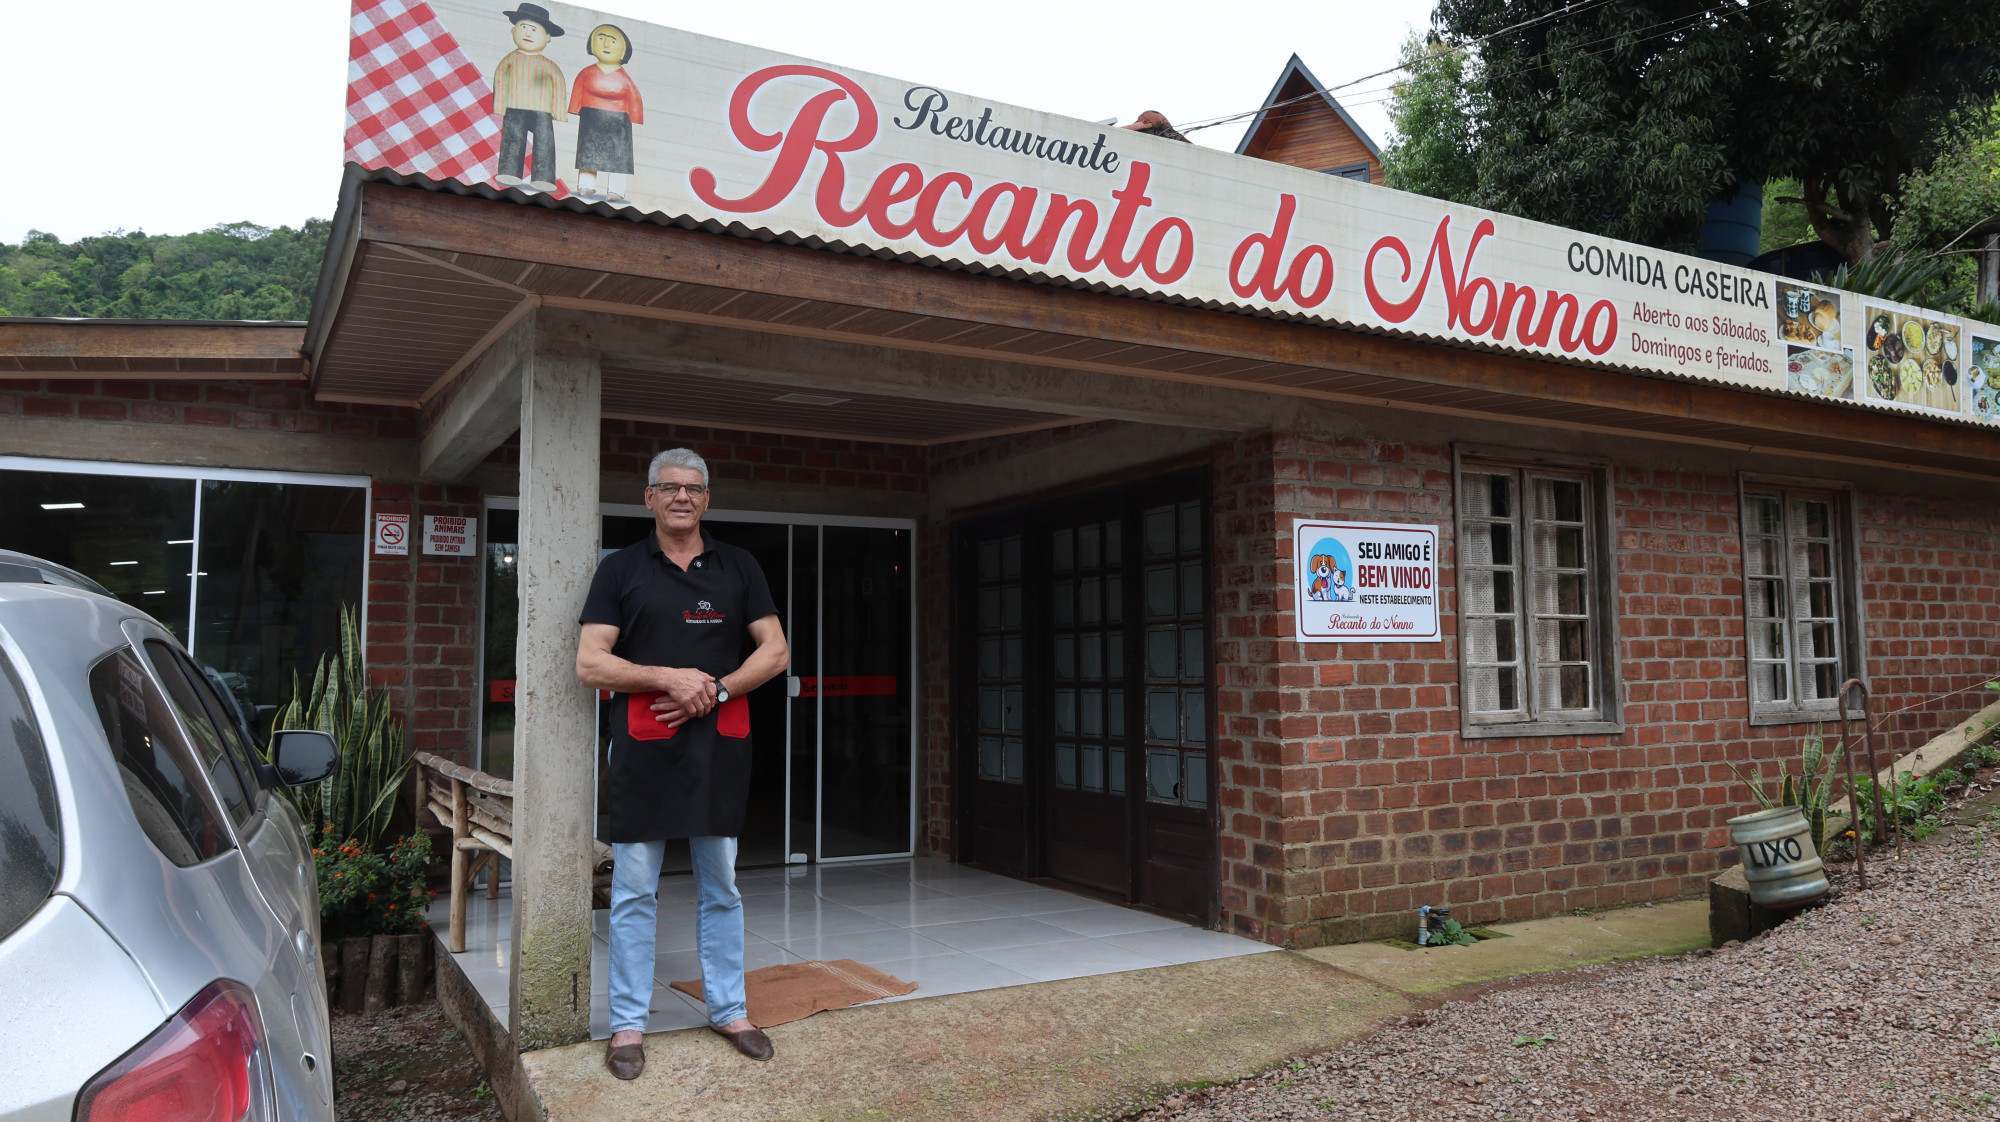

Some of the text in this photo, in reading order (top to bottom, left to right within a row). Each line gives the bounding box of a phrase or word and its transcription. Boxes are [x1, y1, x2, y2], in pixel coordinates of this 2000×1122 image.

[893, 86, 1121, 175] Restaurante
[689, 64, 1618, 356] Recanto do Nonno
[1567, 241, 1769, 309] COMIDA CASEIRA
[1633, 301, 1770, 347] Aberto aos Sábados,
[1631, 332, 1773, 374] Domingos e feriados.
[433, 516, 467, 526] PROIBIDO
[434, 524, 465, 534] ANIMAIS
[434, 543, 444, 552] SEM
[1358, 540, 1430, 561] SEU AMIGO É
[1358, 564, 1431, 589] BEM VINDO
[1359, 594, 1432, 606] NESTE ESTABELECIMENTO
[1327, 613, 1414, 630] Recanto do Nonno
[1748, 837, 1802, 867] LIXO
